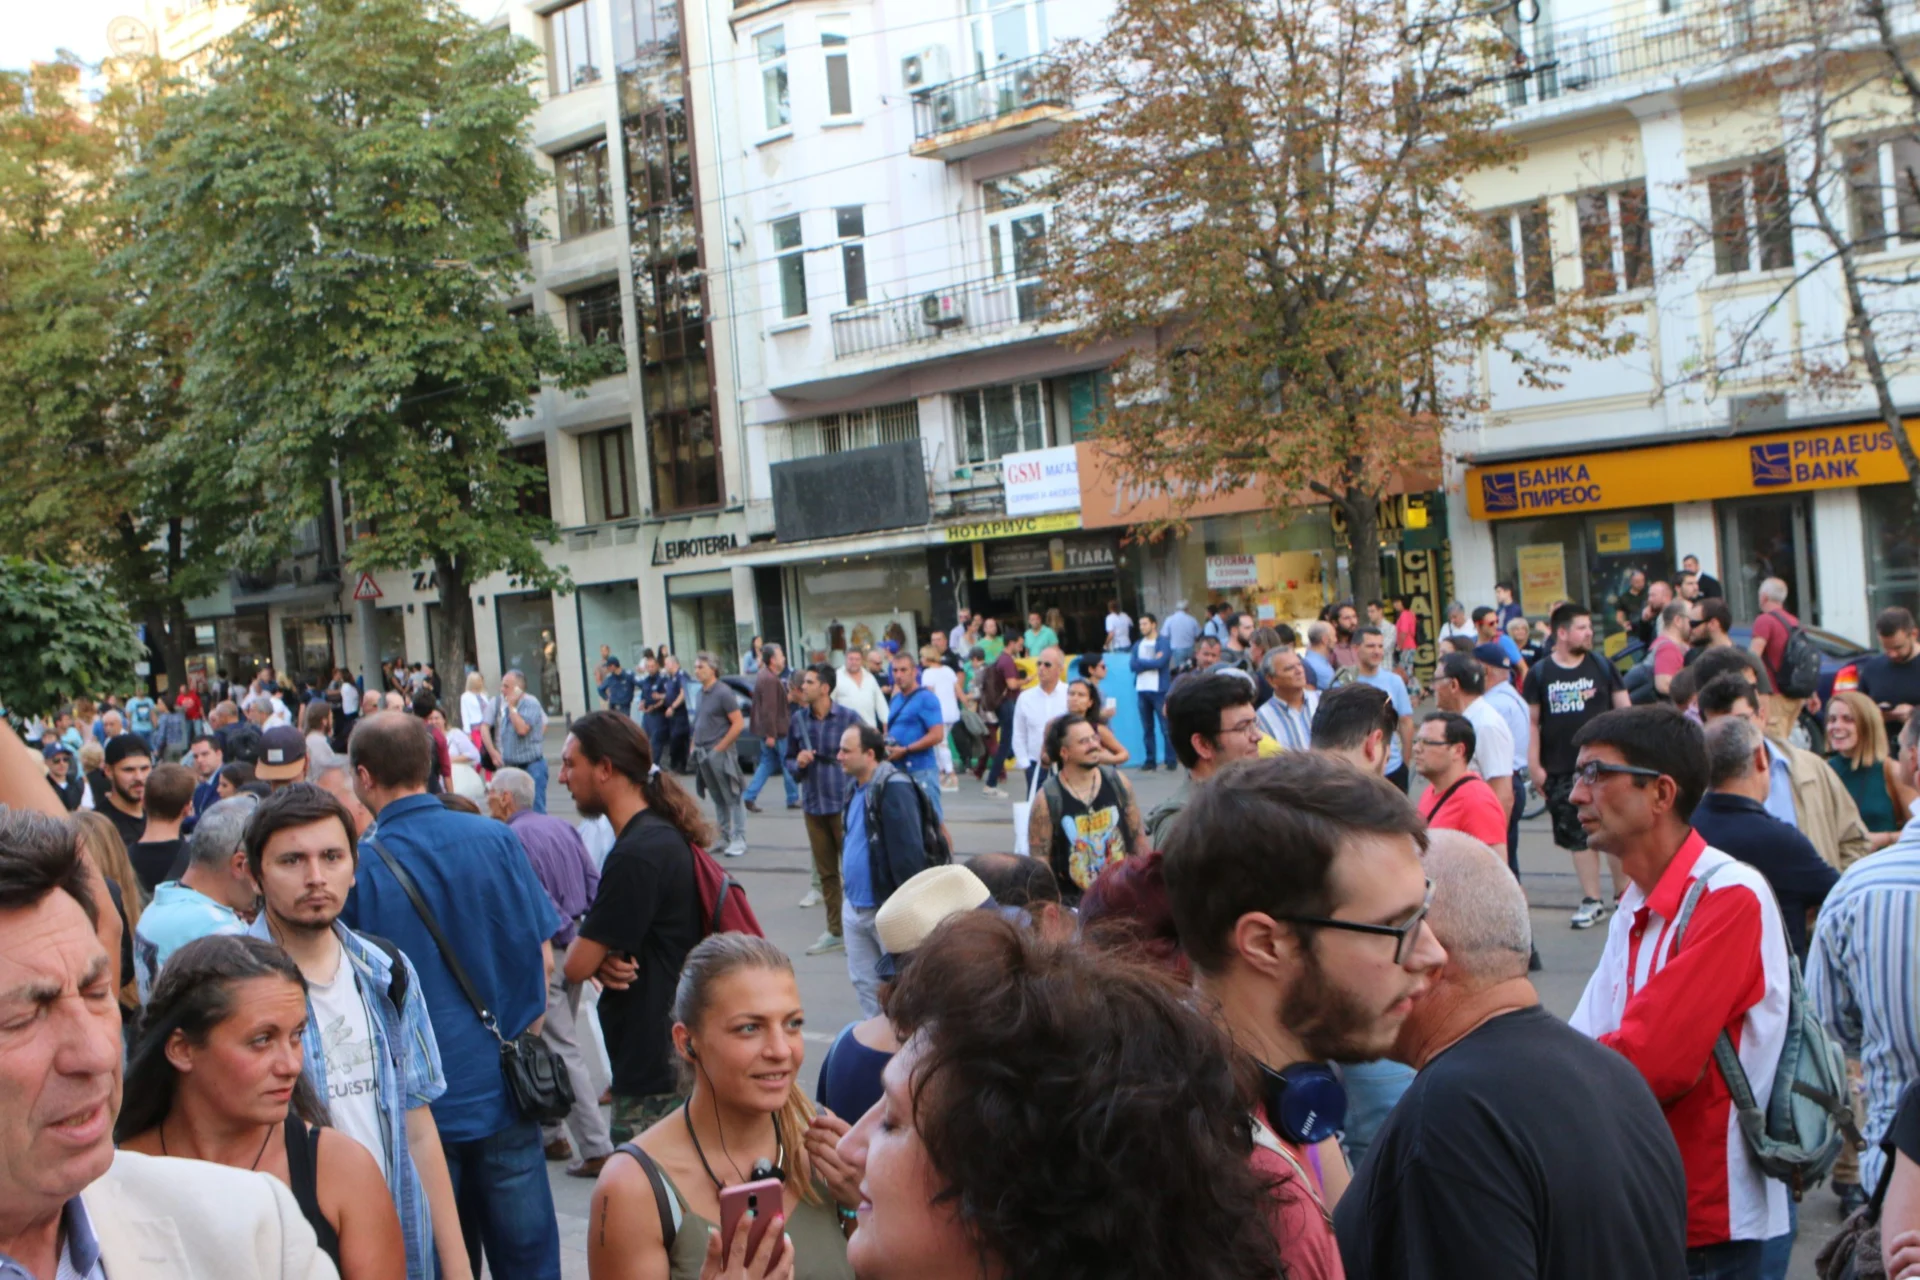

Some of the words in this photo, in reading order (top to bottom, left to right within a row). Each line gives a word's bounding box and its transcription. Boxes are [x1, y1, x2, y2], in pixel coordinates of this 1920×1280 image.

[1794, 432, 1893, 459] PIRAEUS
[1008, 461, 1041, 484] GSM
[1518, 464, 1590, 488] БАНКА
[1796, 459, 1859, 482] BANK
[1521, 485, 1601, 508] ПИРЕОС
[948, 518, 1037, 539] НОТАРИУС
[665, 533, 738, 559] EUROTERRA
[1548, 677, 1594, 694] plovdiv
[1301, 1109, 1317, 1136] SONY
